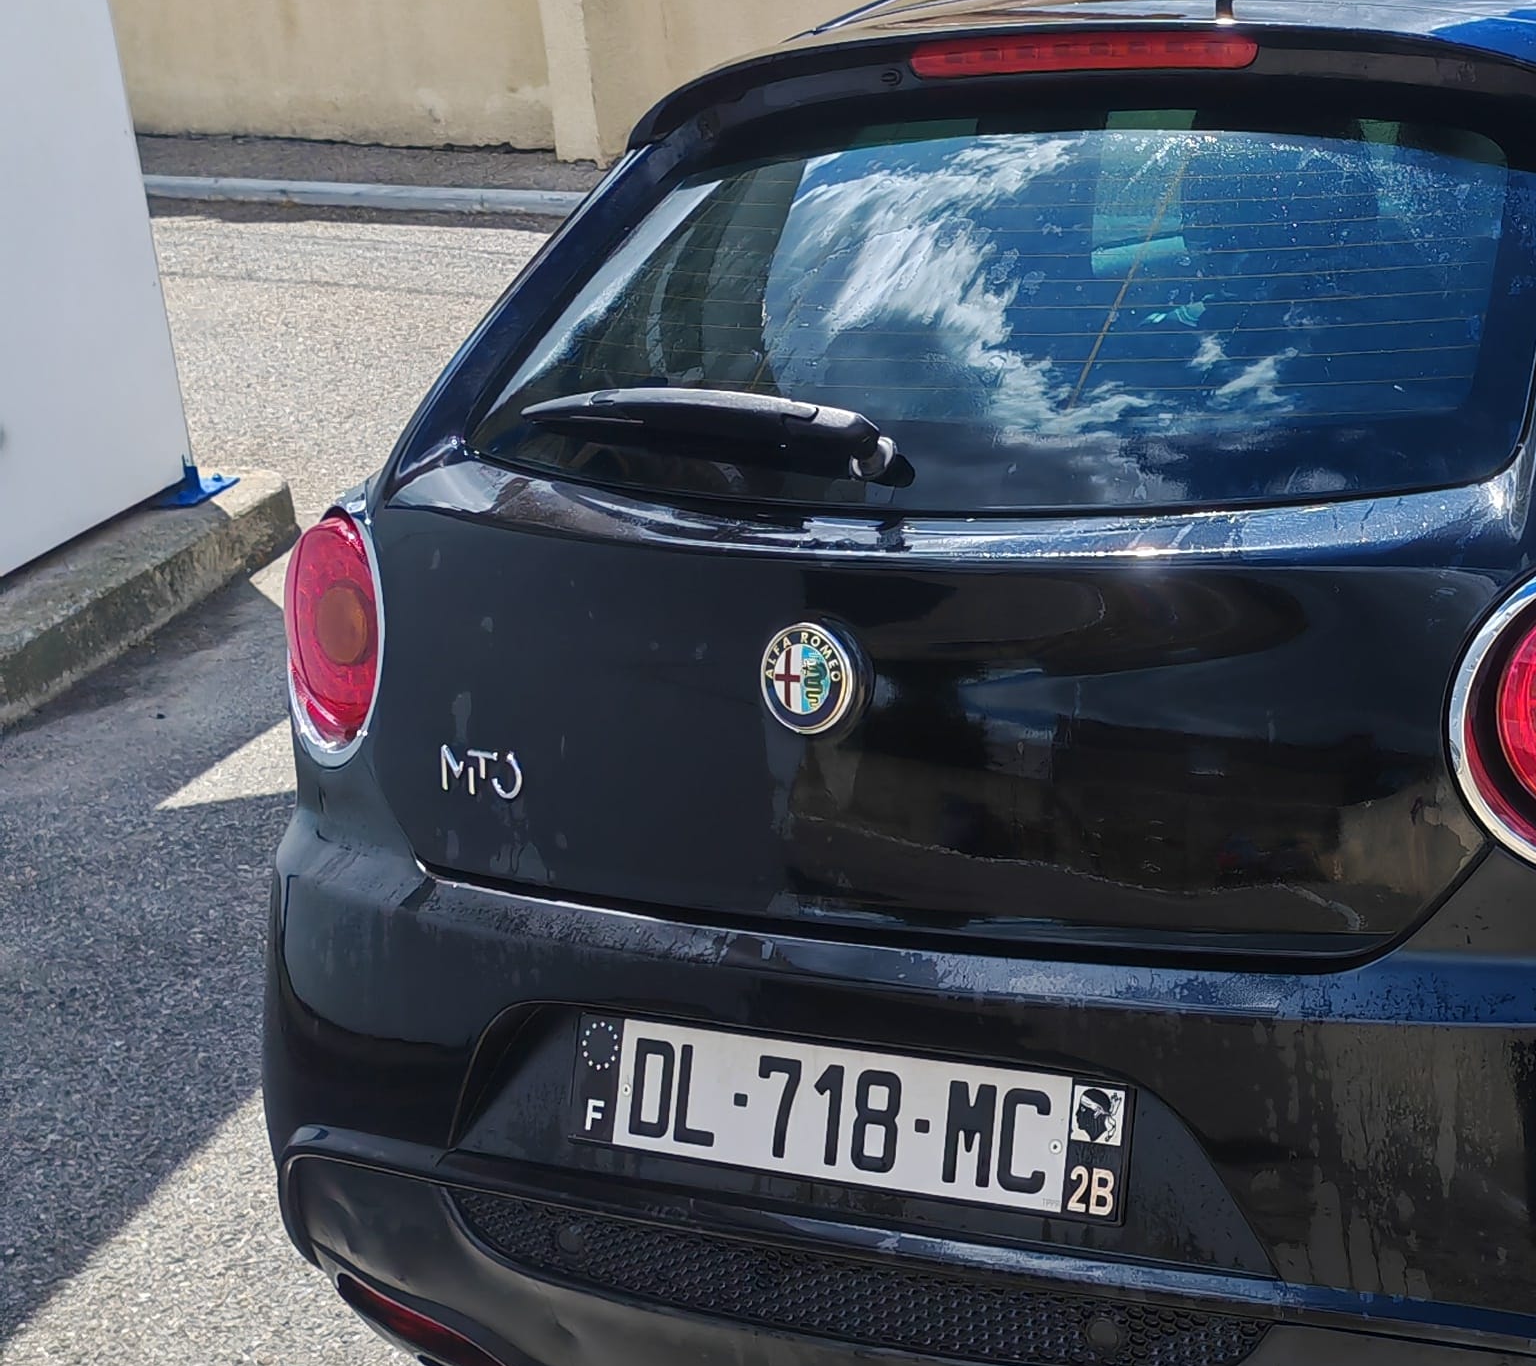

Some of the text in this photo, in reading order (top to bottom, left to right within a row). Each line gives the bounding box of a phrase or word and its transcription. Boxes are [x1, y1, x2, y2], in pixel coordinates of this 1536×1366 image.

[765, 632, 841, 682] ALFA ROMEO
[584, 1098, 606, 1131] F
[1067, 1165, 1115, 1215] 2B
